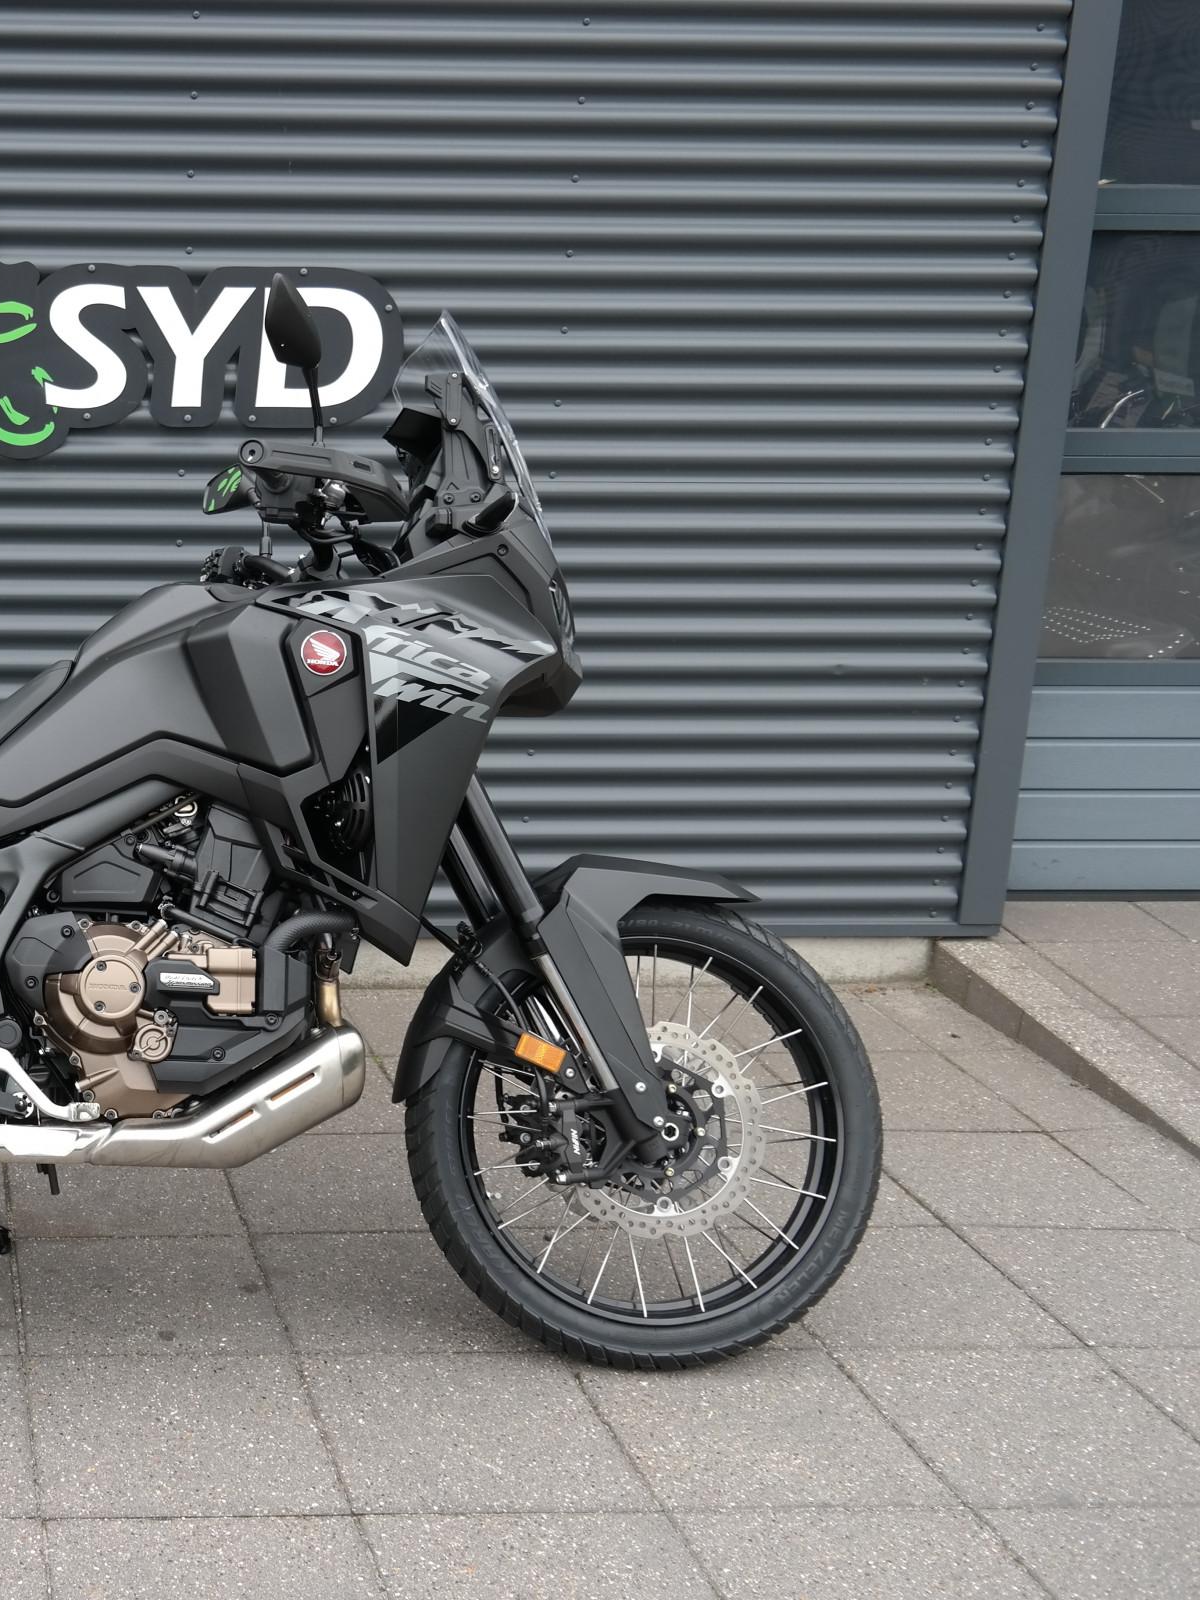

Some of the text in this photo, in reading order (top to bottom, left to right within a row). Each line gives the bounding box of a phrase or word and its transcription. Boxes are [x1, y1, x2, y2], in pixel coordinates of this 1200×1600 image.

[44, 283, 384, 409] SYD
[306, 658, 340, 667] HONDA
[775, 1210, 849, 1300] METZELER
